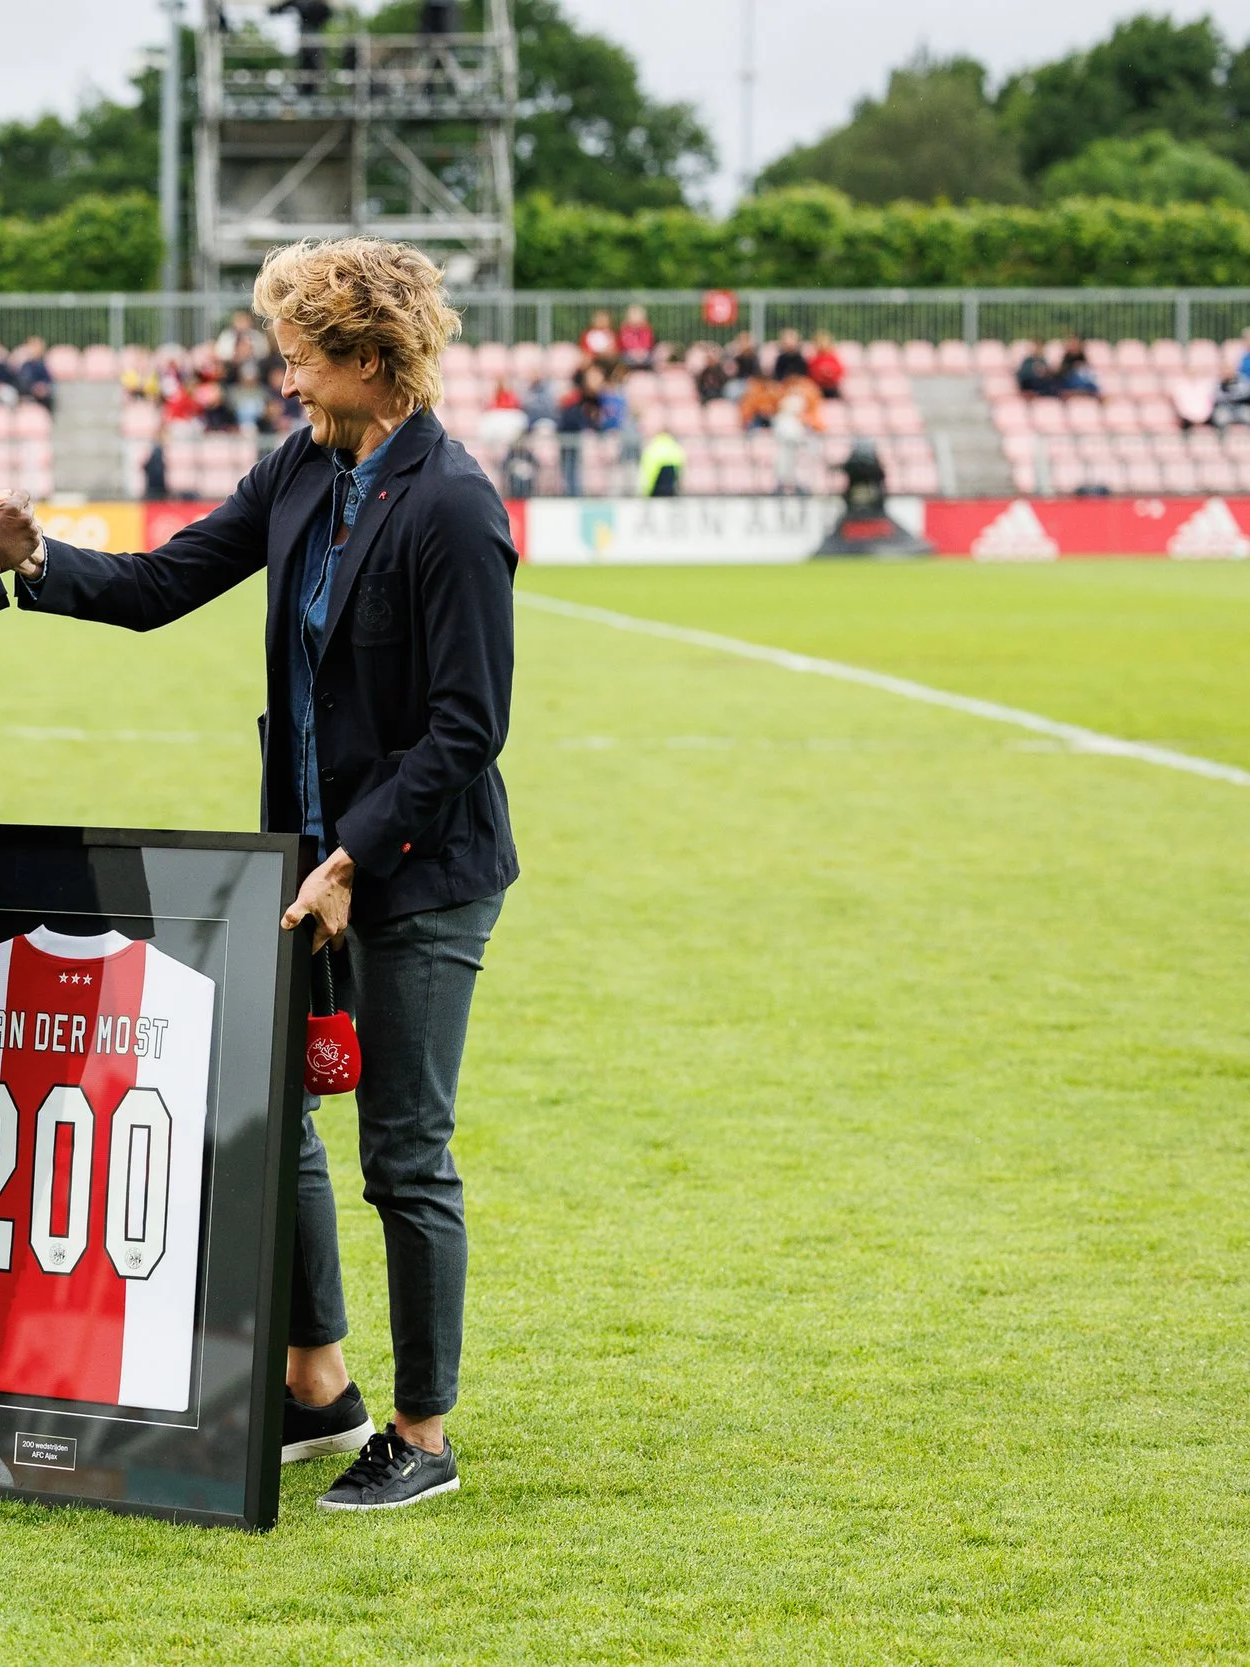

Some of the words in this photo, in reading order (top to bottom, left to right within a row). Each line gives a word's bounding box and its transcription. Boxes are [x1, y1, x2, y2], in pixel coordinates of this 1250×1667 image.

[34, 1012, 87, 1053] DER
[95, 1014, 169, 1059] MOST
[22, 1440, 34, 1448] 200
[31, 1451, 44, 1459] AFC
[45, 1452, 57, 1460] Ajax
